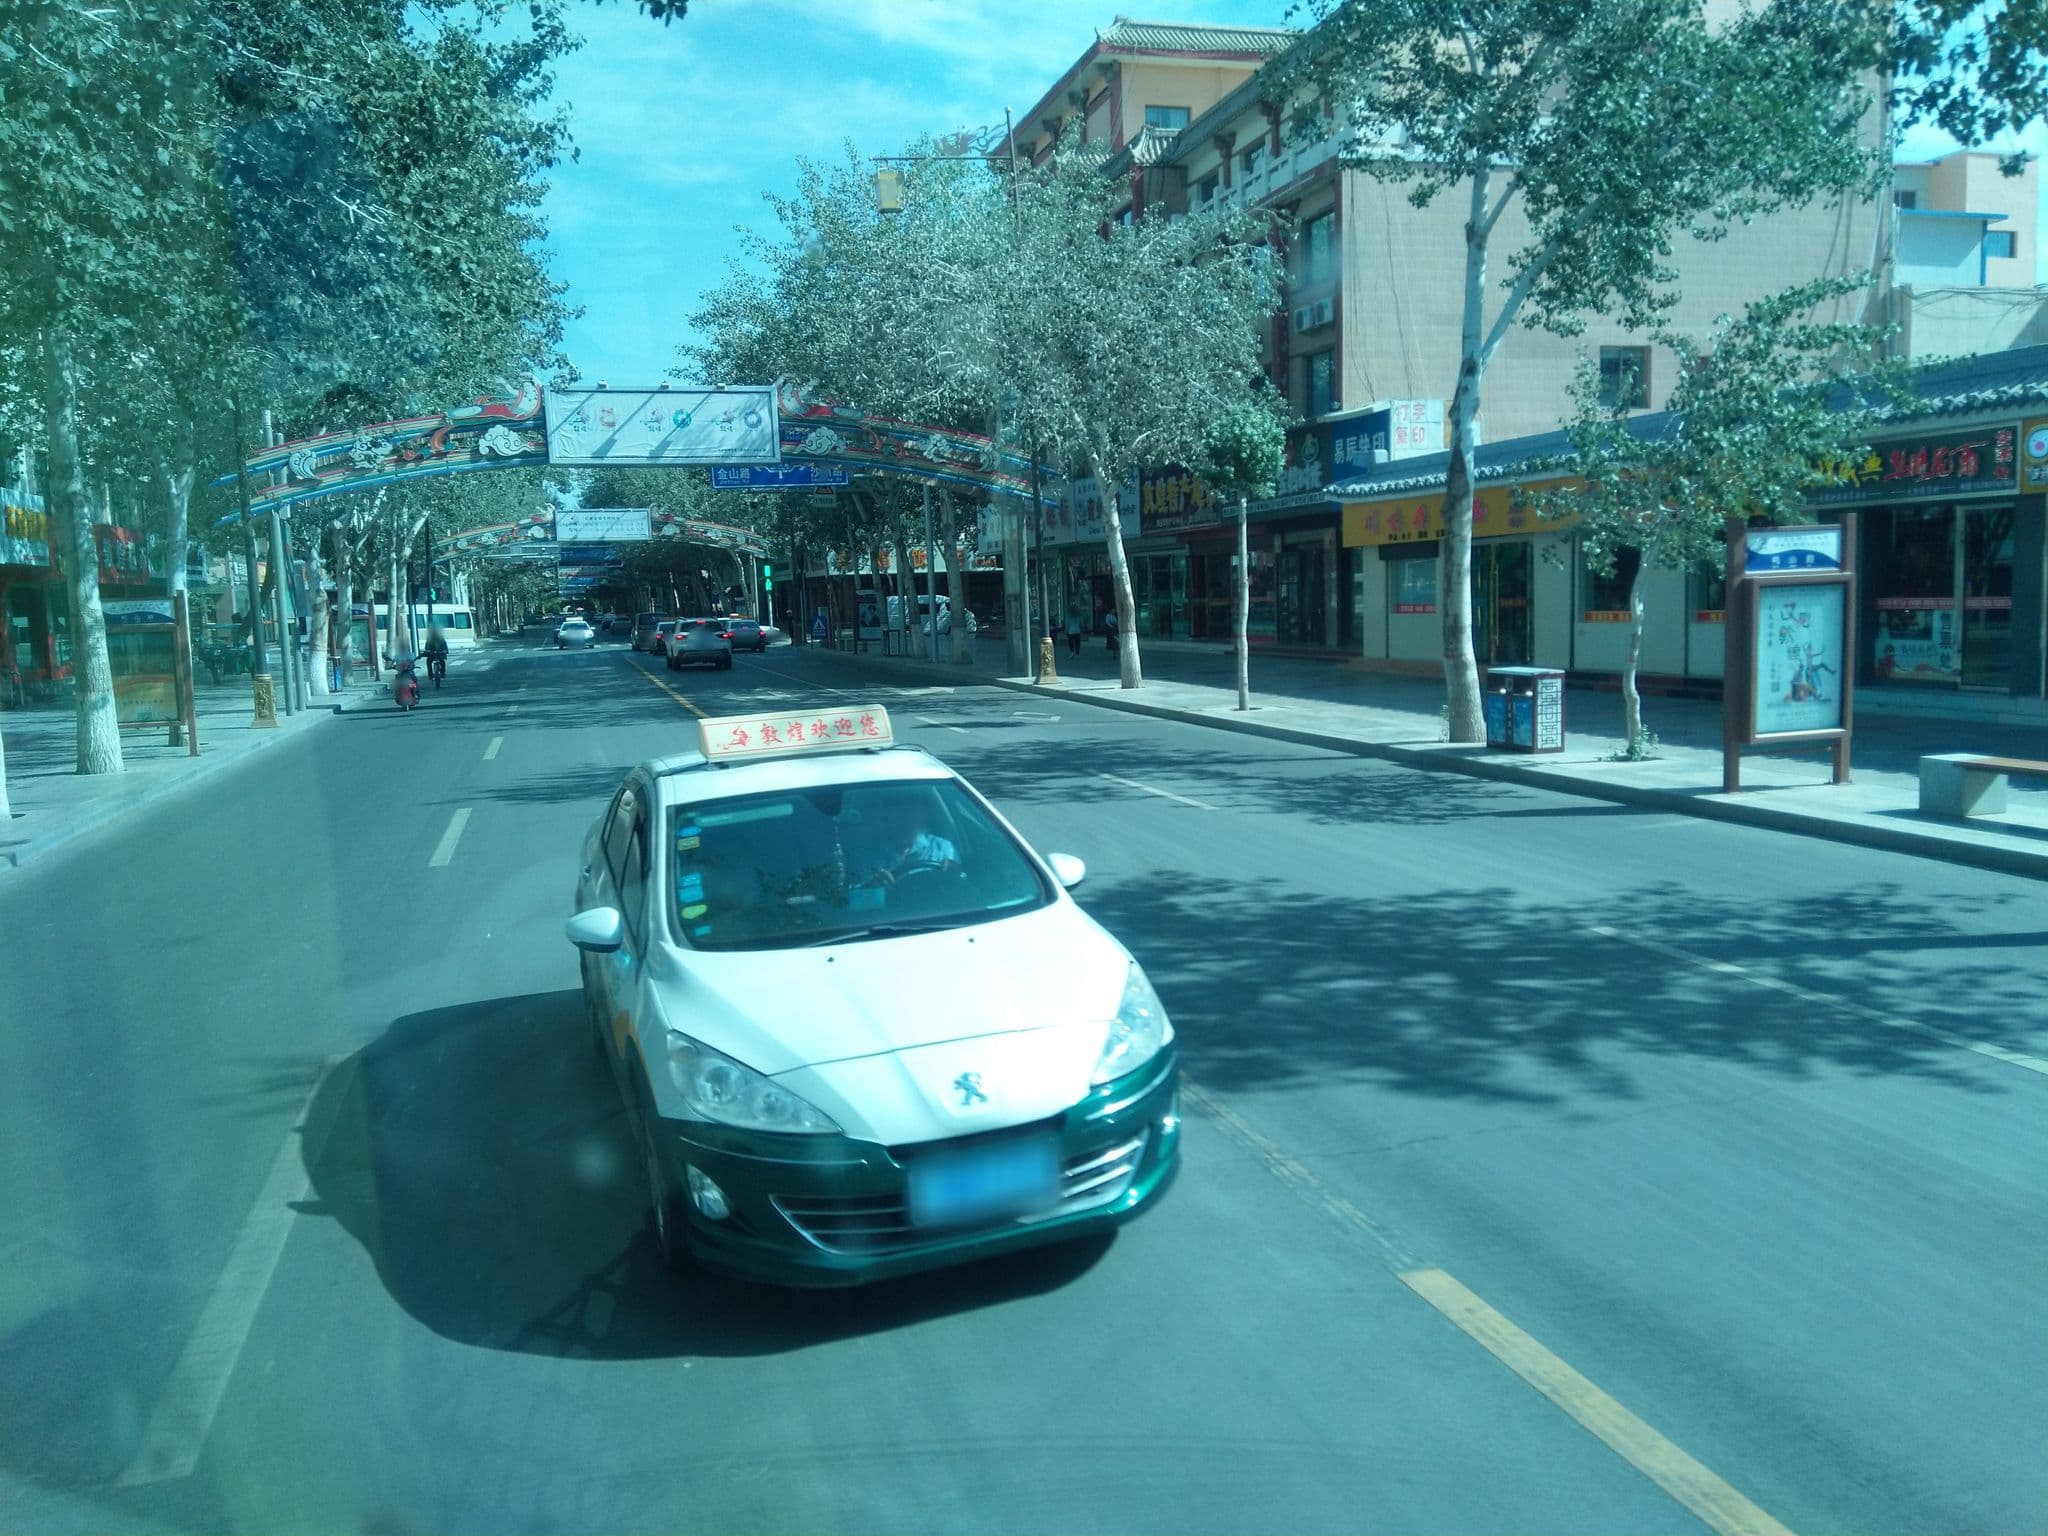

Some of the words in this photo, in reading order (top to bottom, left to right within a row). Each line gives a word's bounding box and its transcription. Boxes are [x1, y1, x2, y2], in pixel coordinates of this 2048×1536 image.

[1395, 404, 1425, 421] 打字
[717, 467, 750, 479] 金山路
[760, 712, 881, 746] 敦煌欢迎您
